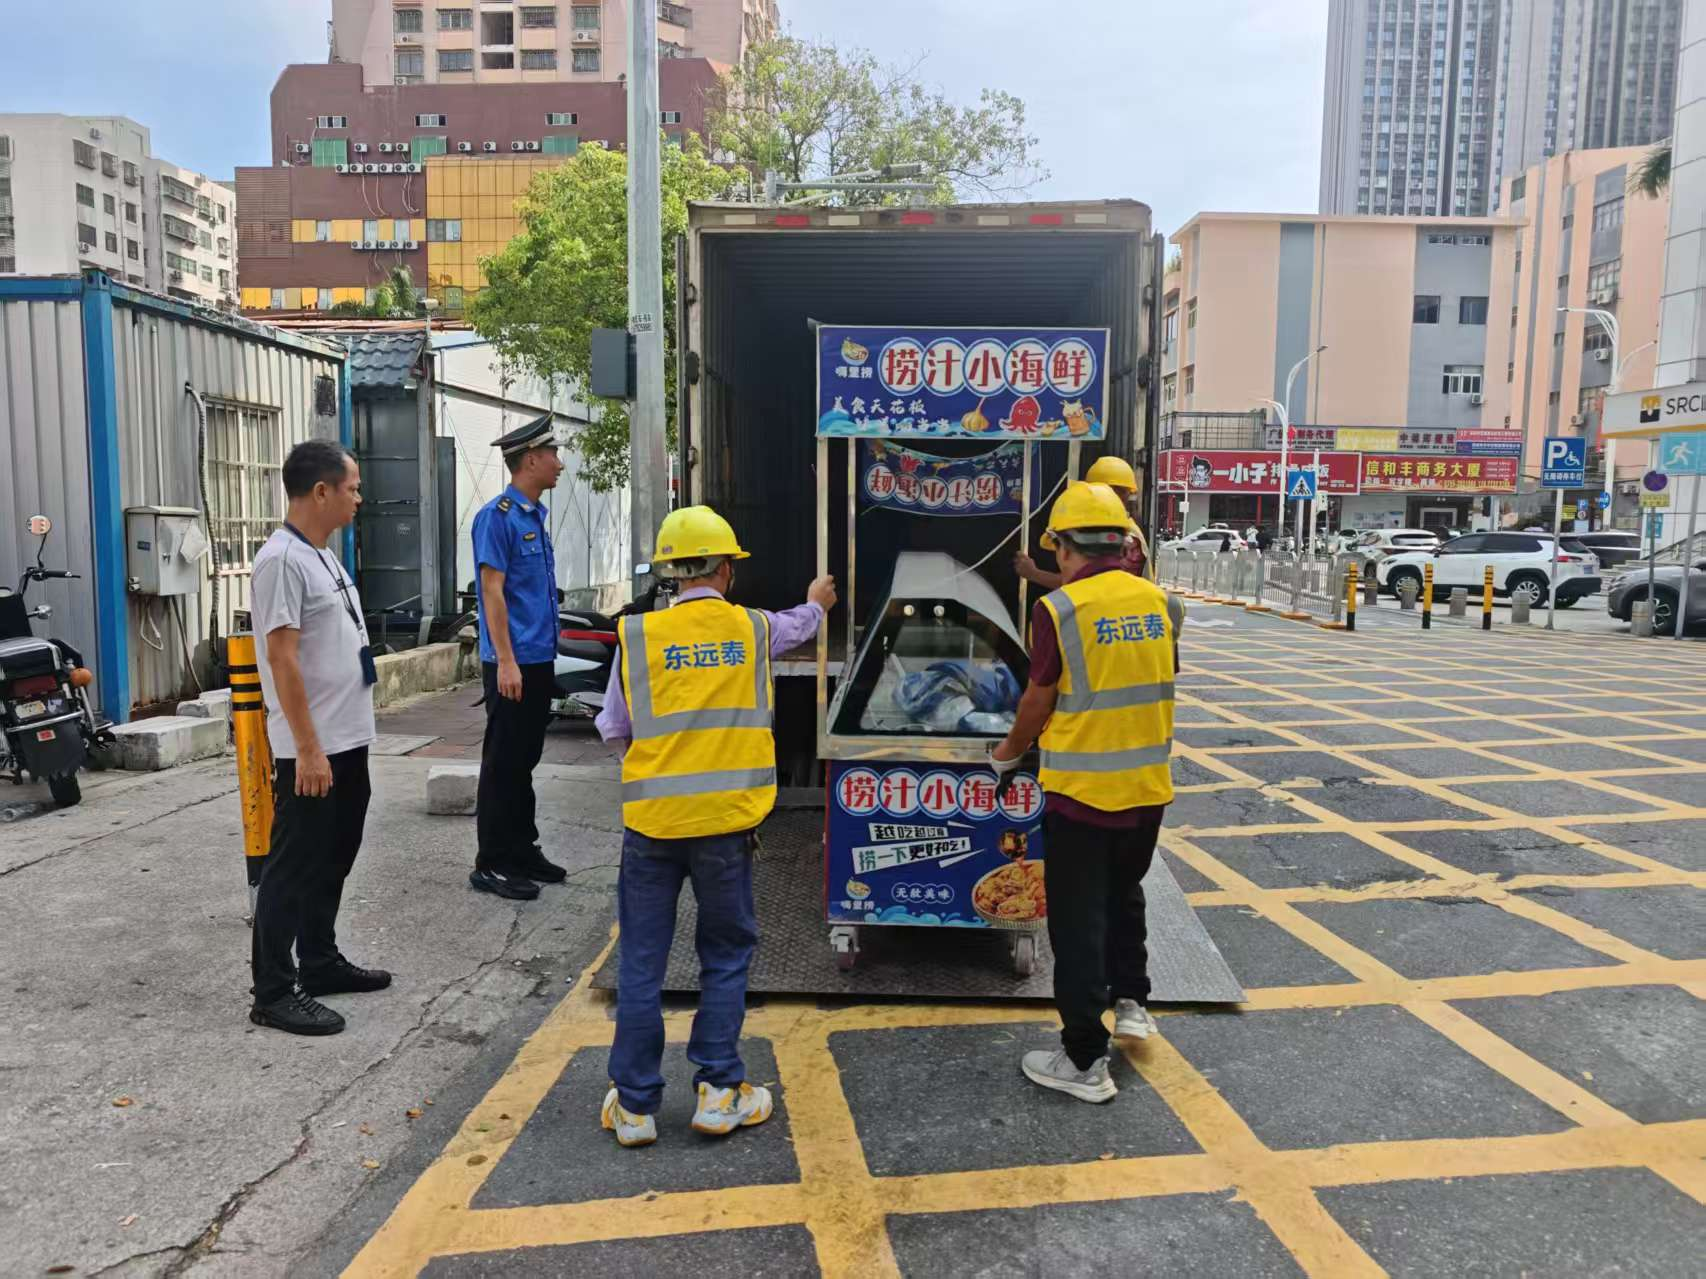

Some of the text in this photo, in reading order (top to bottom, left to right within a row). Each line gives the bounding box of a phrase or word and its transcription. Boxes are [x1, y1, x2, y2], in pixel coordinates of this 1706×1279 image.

[885, 348, 1089, 388] 捞汁小海鲜
[833, 397, 927, 415] 美食天花板
[1366, 460, 1481, 478] 信和丰商务大厦
[1547, 440, 1568, 469] P
[1094, 613, 1165, 644] 东远泰
[663, 641, 746, 671] 东远泰
[844, 776, 1038, 814] 捞汁小海鲜
